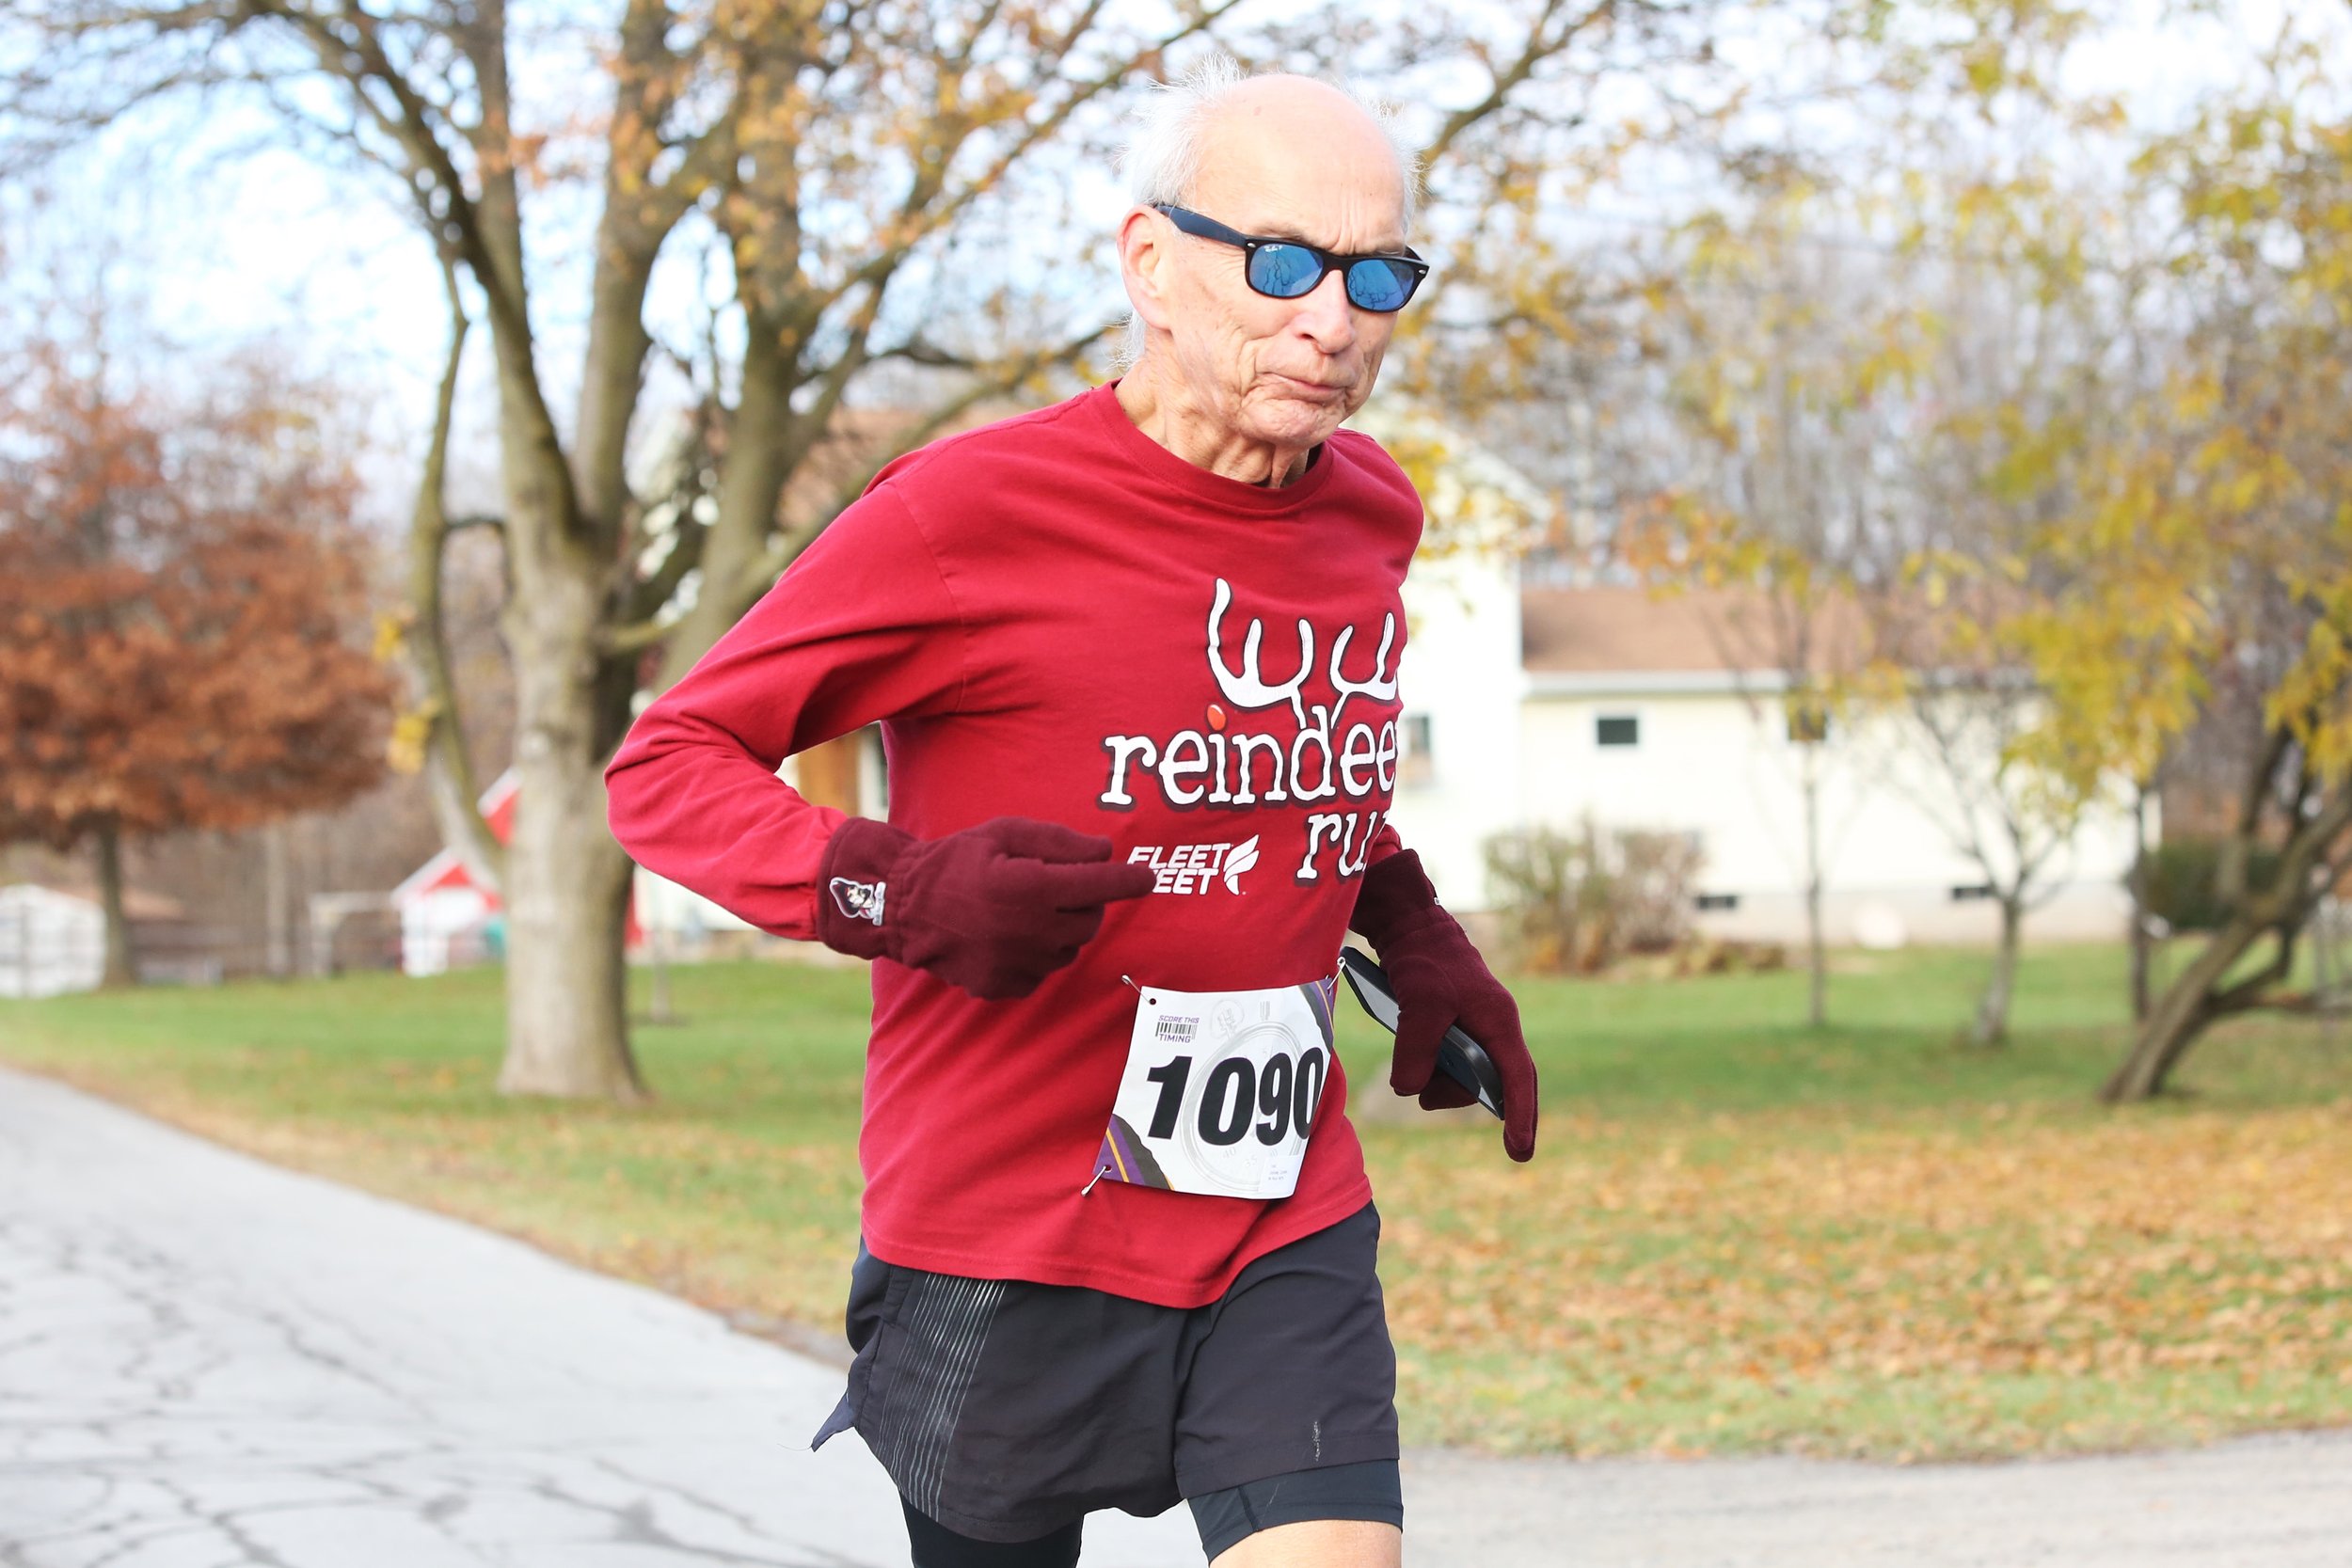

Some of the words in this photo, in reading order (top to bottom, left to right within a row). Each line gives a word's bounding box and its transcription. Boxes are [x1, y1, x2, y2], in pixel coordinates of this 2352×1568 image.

[1101, 705, 1398, 805] reindee
[1126, 843, 1232, 869] FLEET
[1296, 810, 1390, 879] ru
[1152, 867, 1219, 895] EET
[1158, 1034, 1191, 1043] TIMING
[1147, 1047, 1324, 1146] 1090
